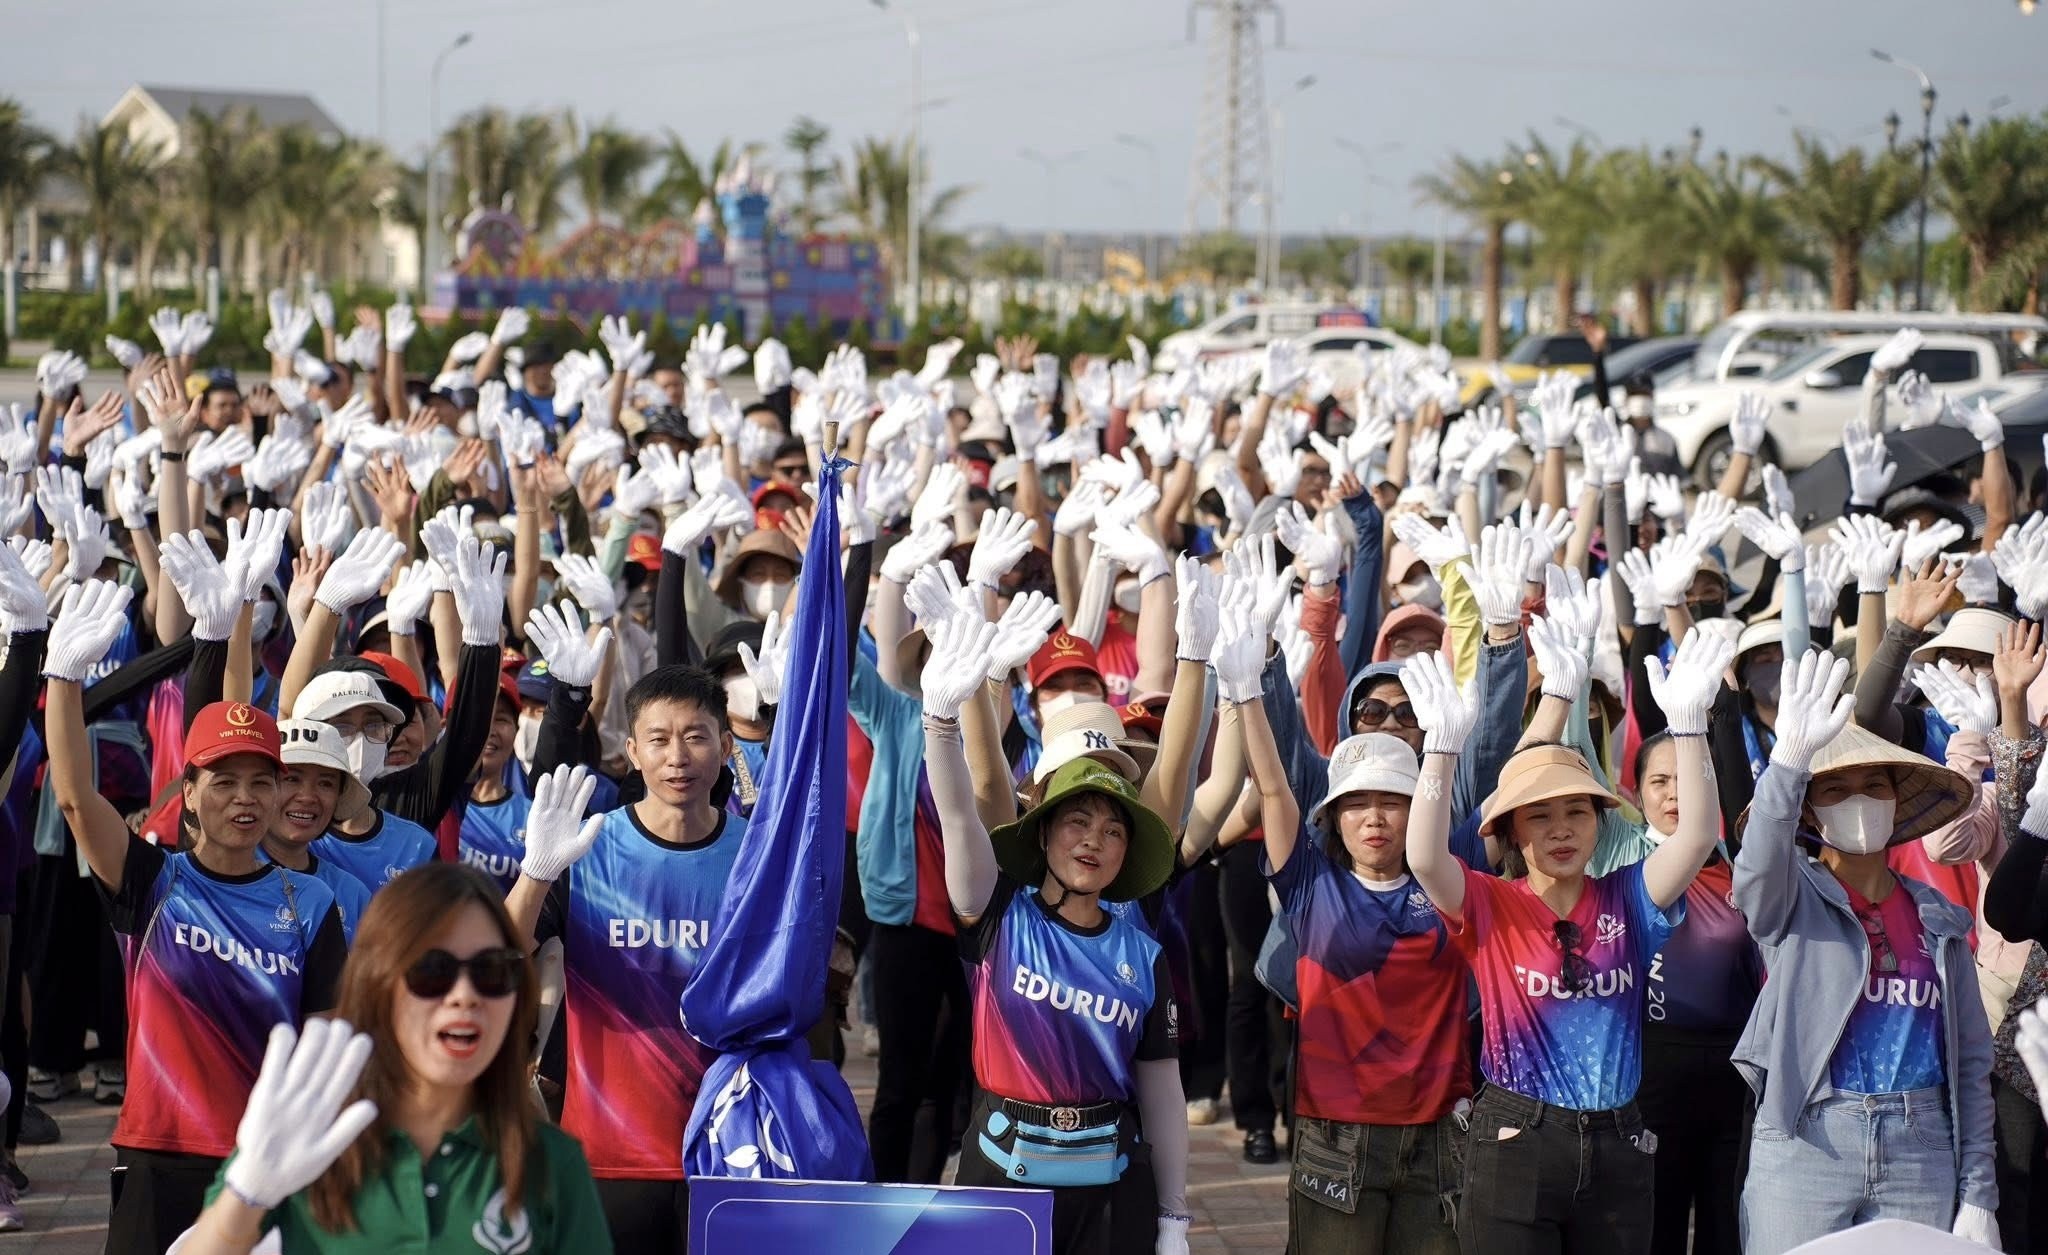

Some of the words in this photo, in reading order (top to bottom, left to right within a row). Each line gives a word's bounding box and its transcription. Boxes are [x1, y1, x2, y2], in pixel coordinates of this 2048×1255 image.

[219, 729, 233, 738] VIN
[235, 729, 264, 739] TRAVEL
[1012, 963, 1139, 1033] EDURUN
